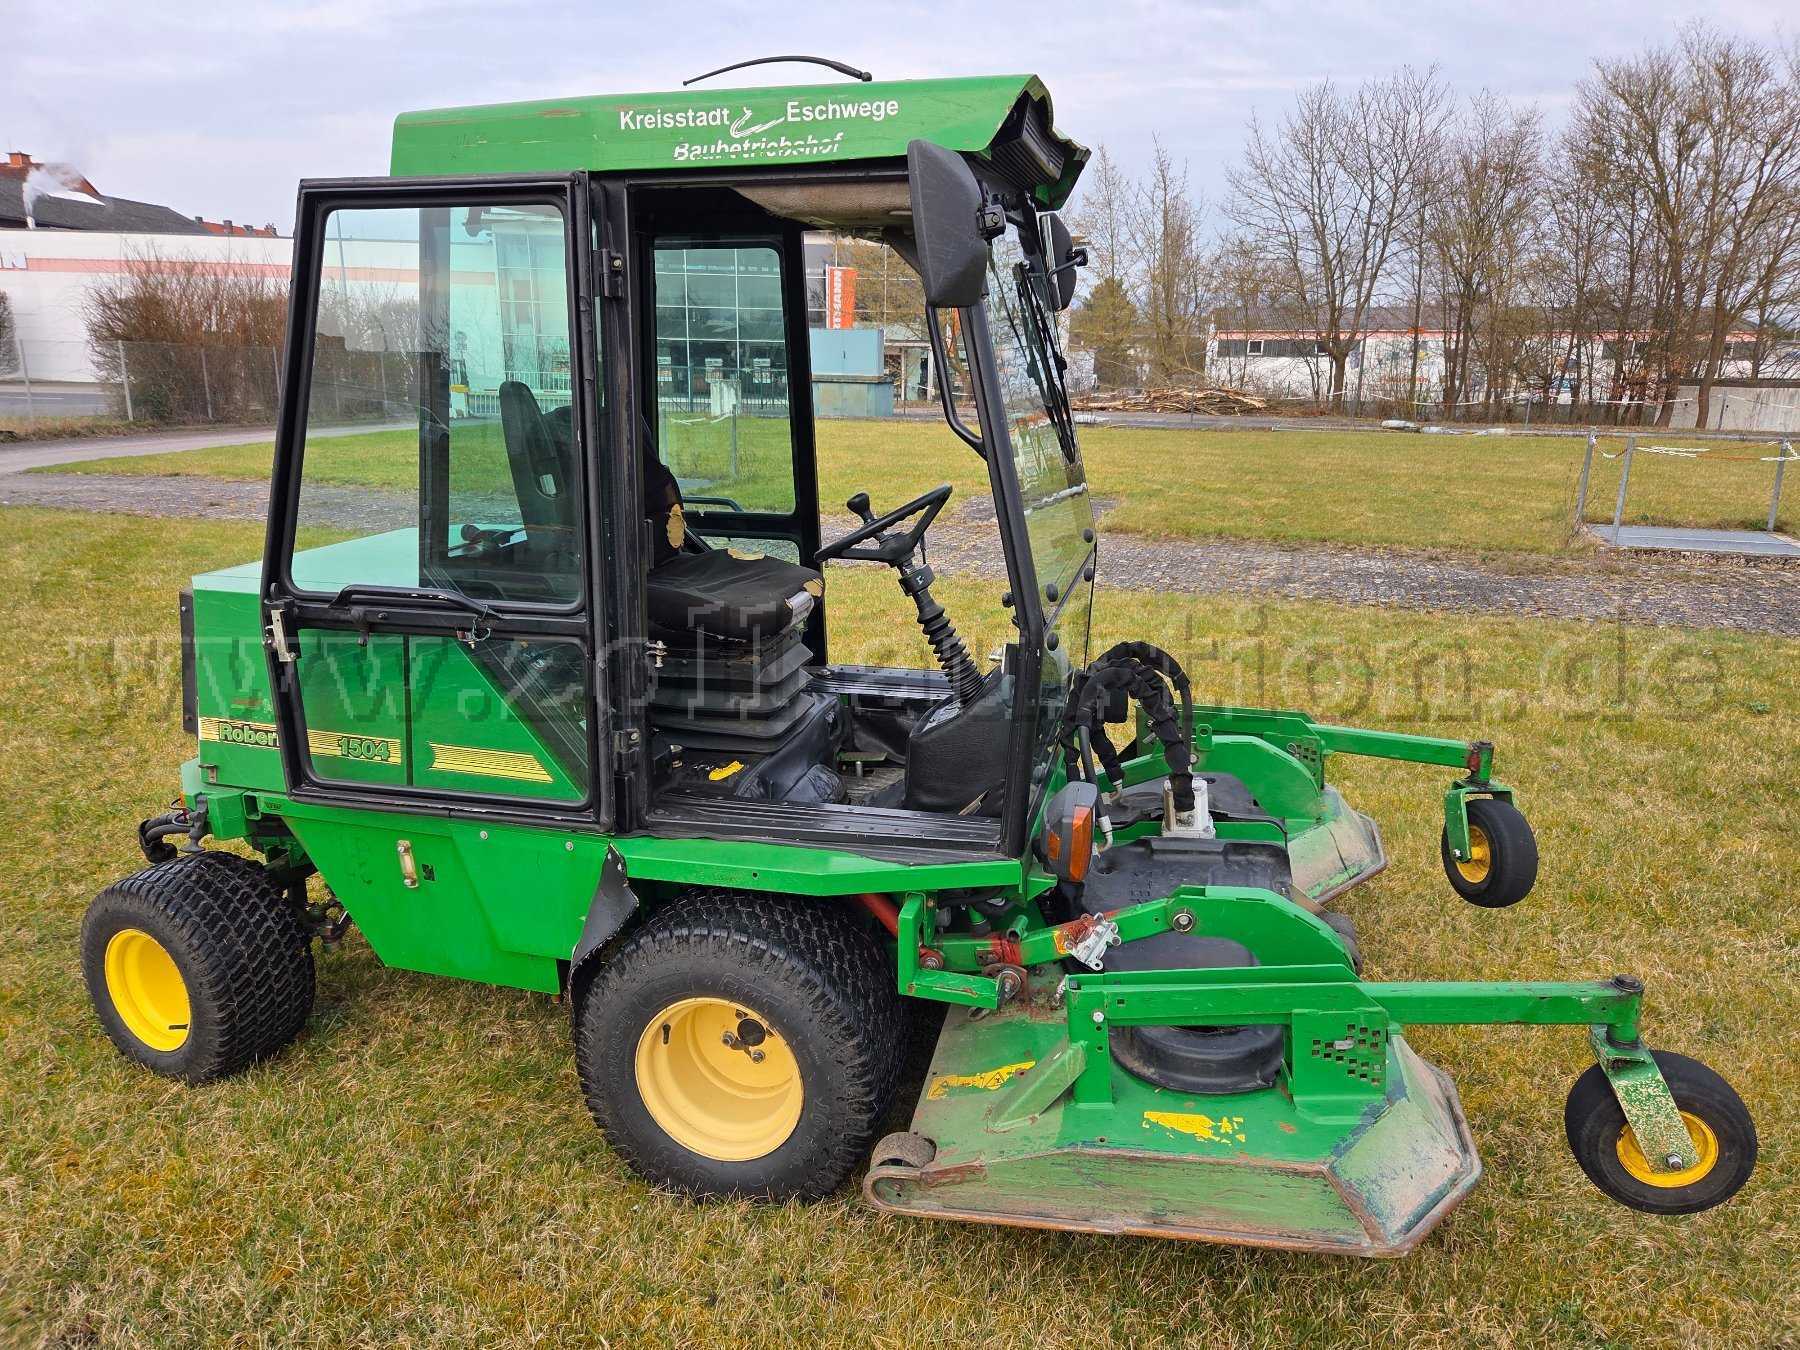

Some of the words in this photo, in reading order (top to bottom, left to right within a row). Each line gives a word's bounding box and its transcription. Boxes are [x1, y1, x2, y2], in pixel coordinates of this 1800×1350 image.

[620, 108, 730, 130] Kreisstadt
[786, 99, 899, 122] Eschwege
[338, 736, 391, 761] 1504
